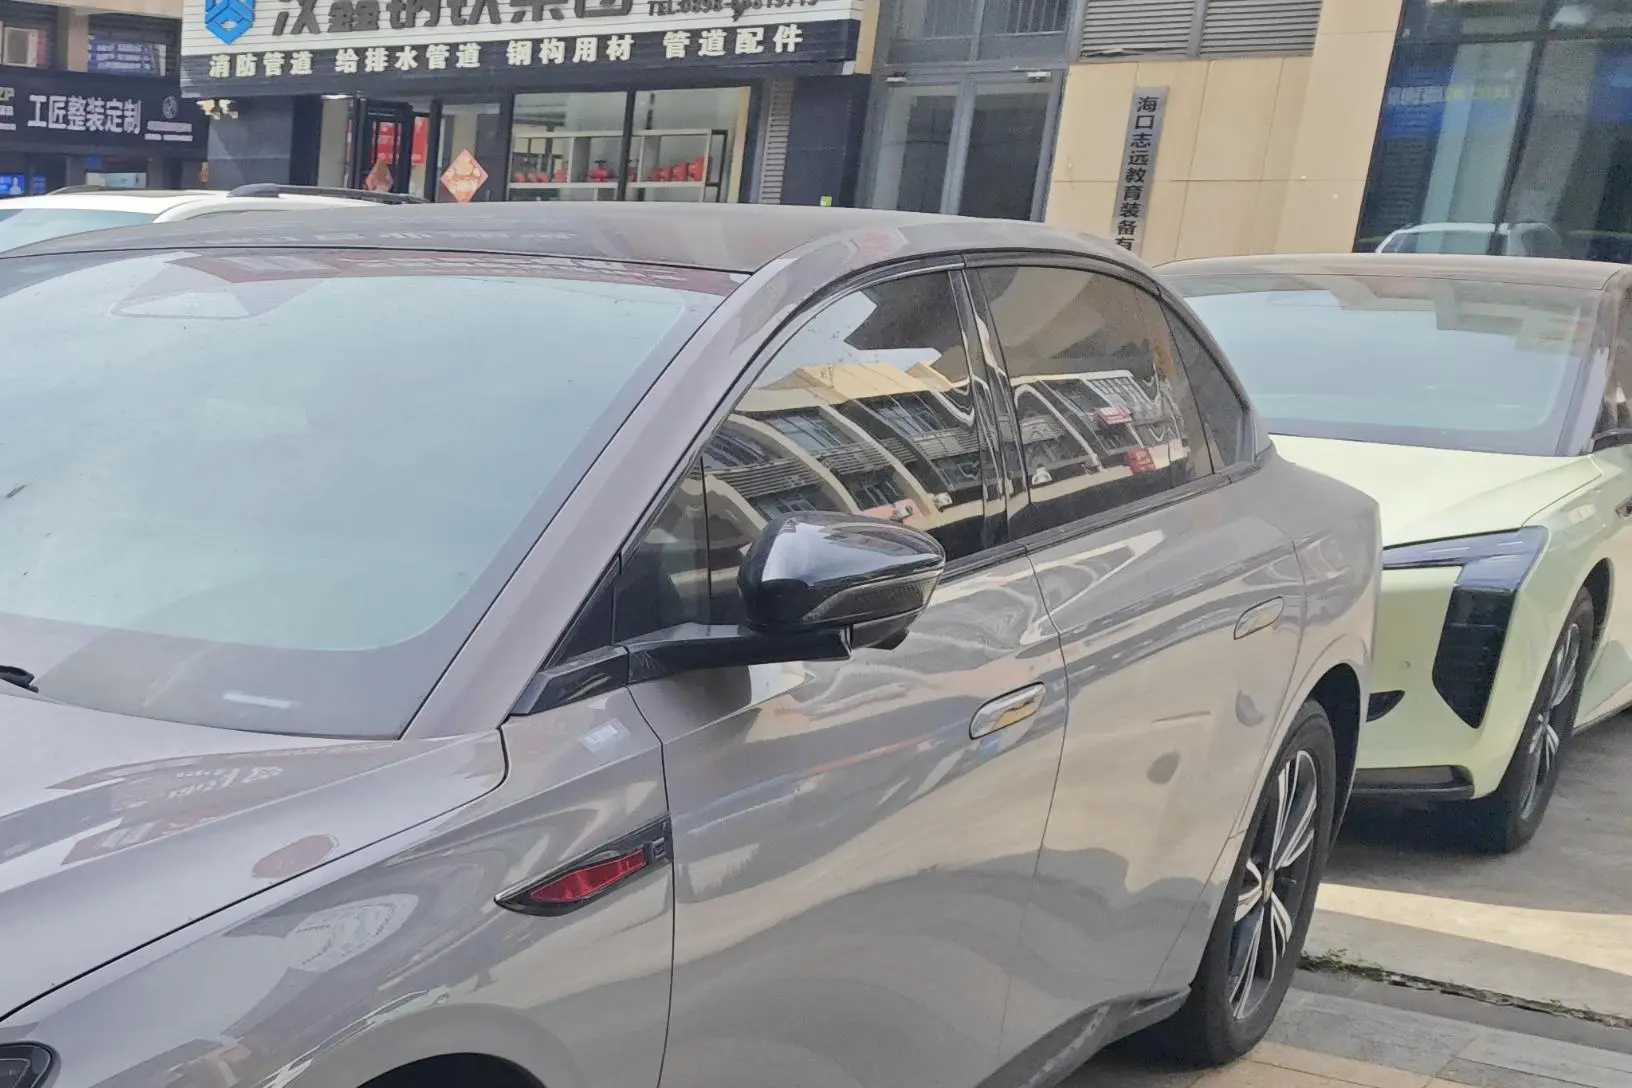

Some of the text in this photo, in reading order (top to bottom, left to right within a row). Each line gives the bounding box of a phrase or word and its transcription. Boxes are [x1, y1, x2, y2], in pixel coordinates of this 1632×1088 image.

[208, 24, 804, 78] 消防管道 给排水管道 钢构用材 管道配件
[27, 94, 143, 135] 工匠整装定制
[1115, 96, 1159, 251] 海口志远教育装备有
